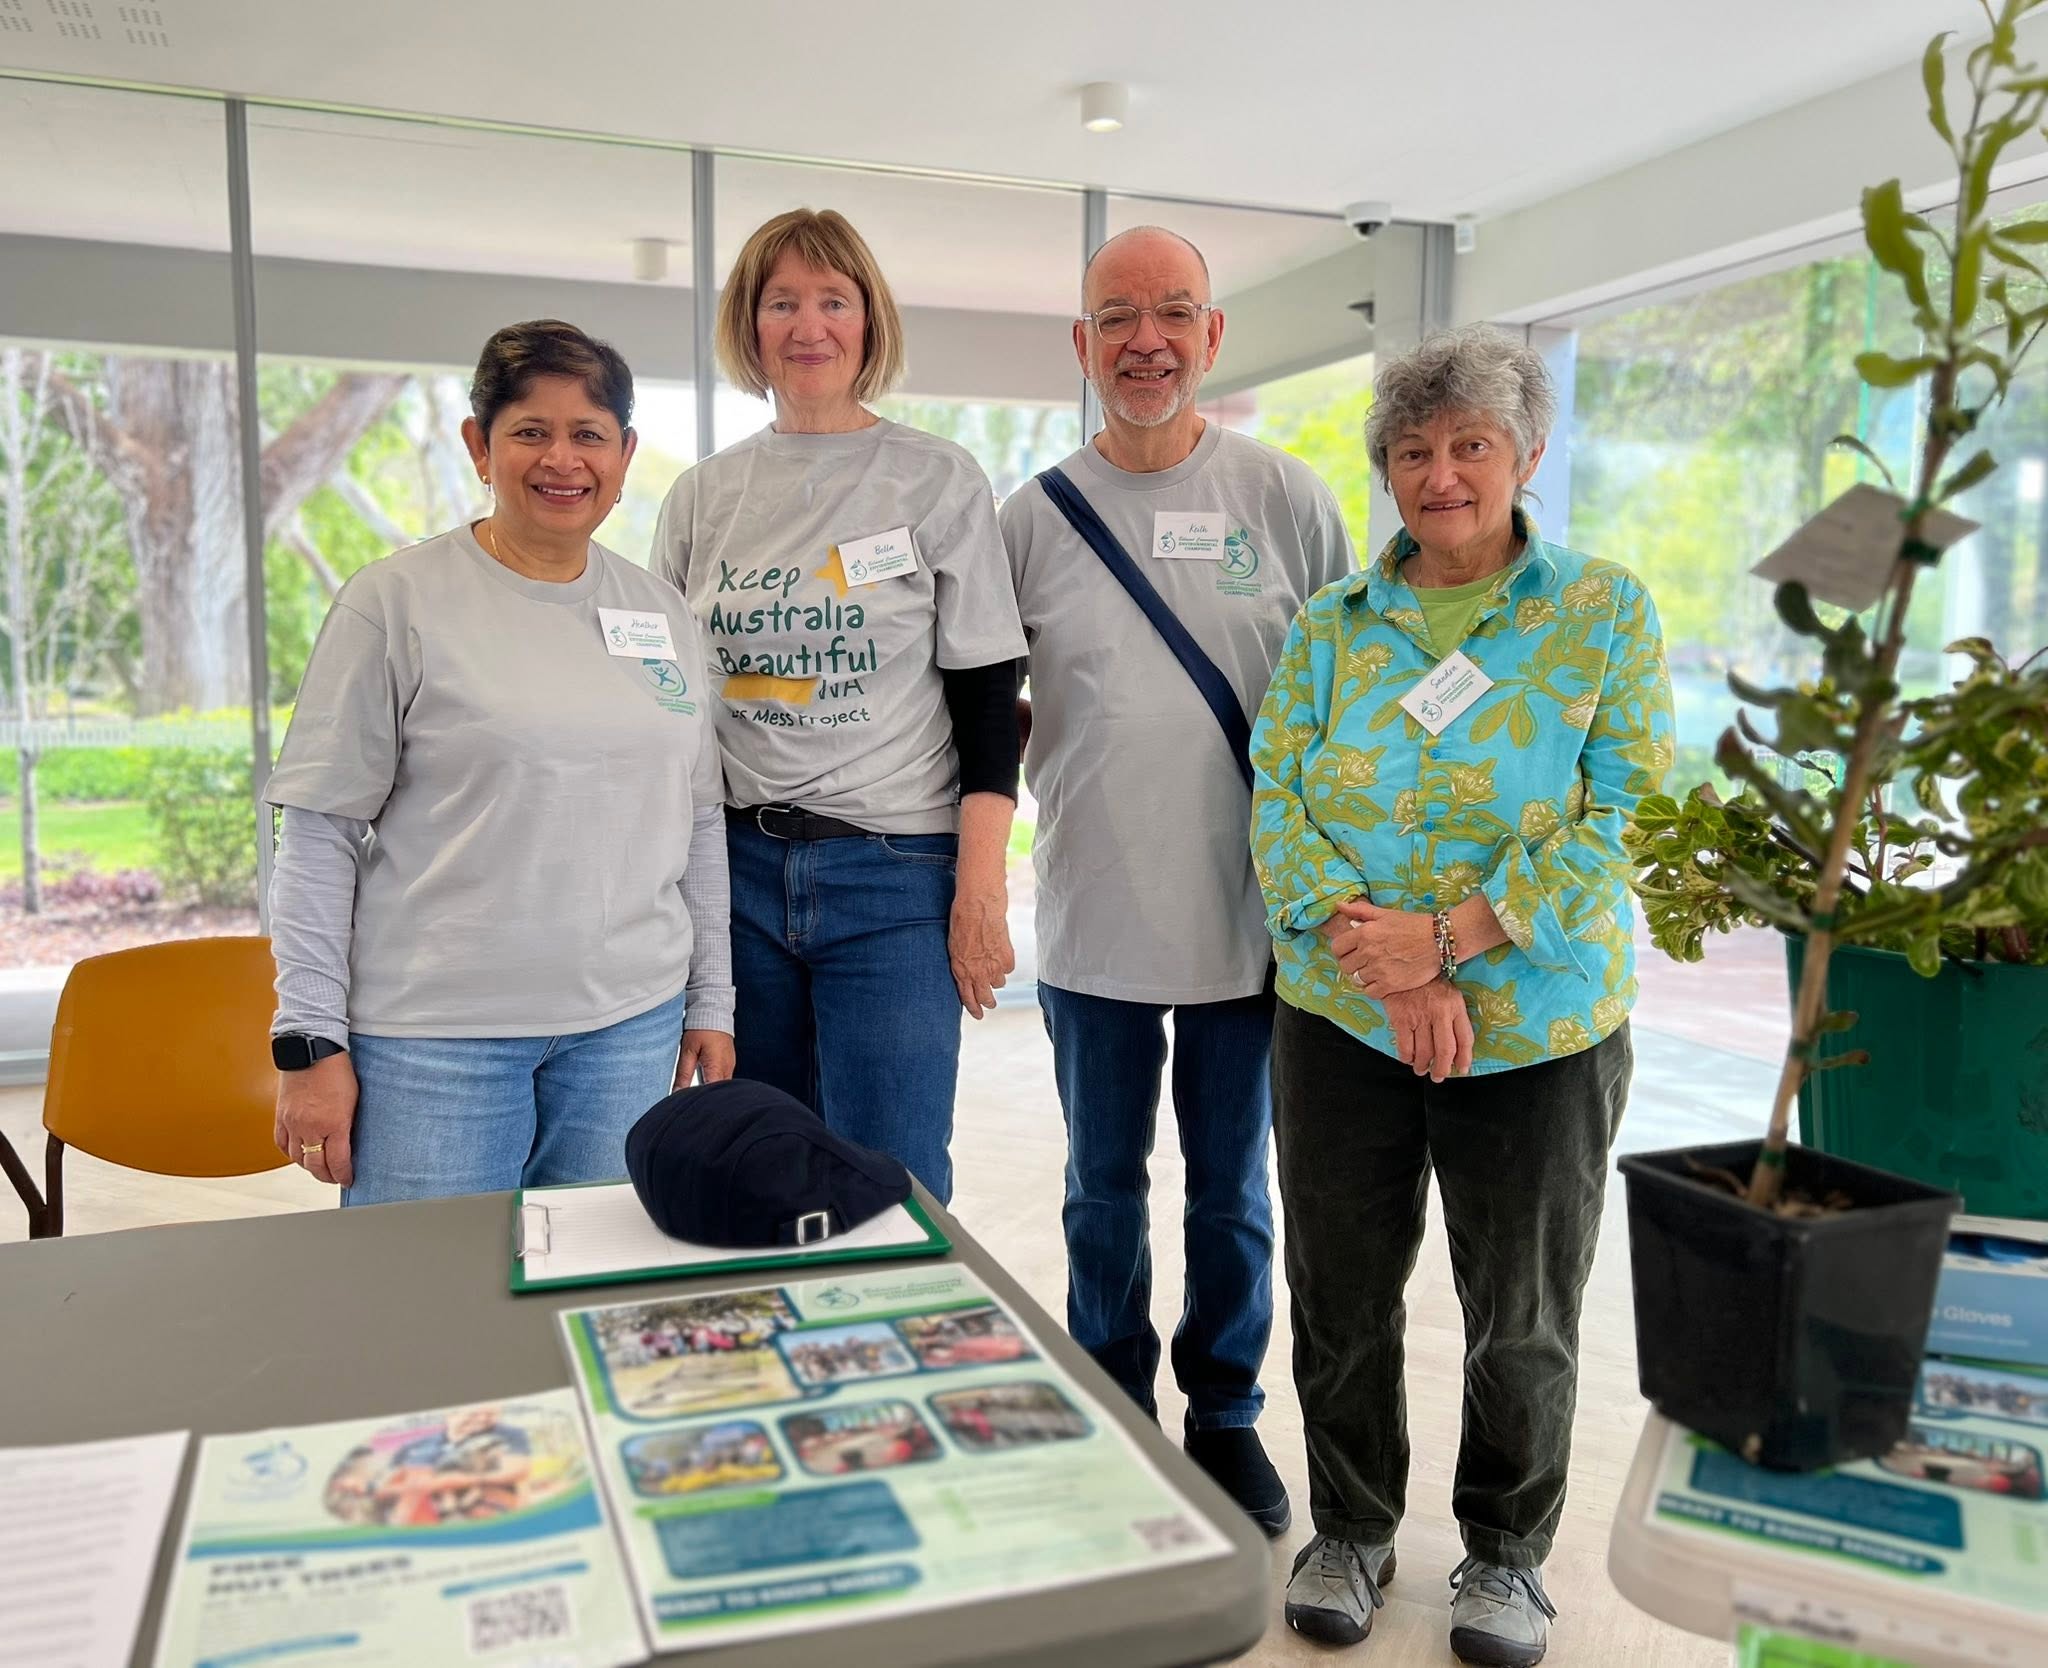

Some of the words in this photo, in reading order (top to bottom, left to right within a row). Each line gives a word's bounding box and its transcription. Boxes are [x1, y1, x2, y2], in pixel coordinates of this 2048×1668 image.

[710, 596, 865, 636] Australia
[716, 635, 878, 677] Beautiful
[752, 708, 794, 726] Mess
[1943, 1305, 2014, 1328] Gloves
